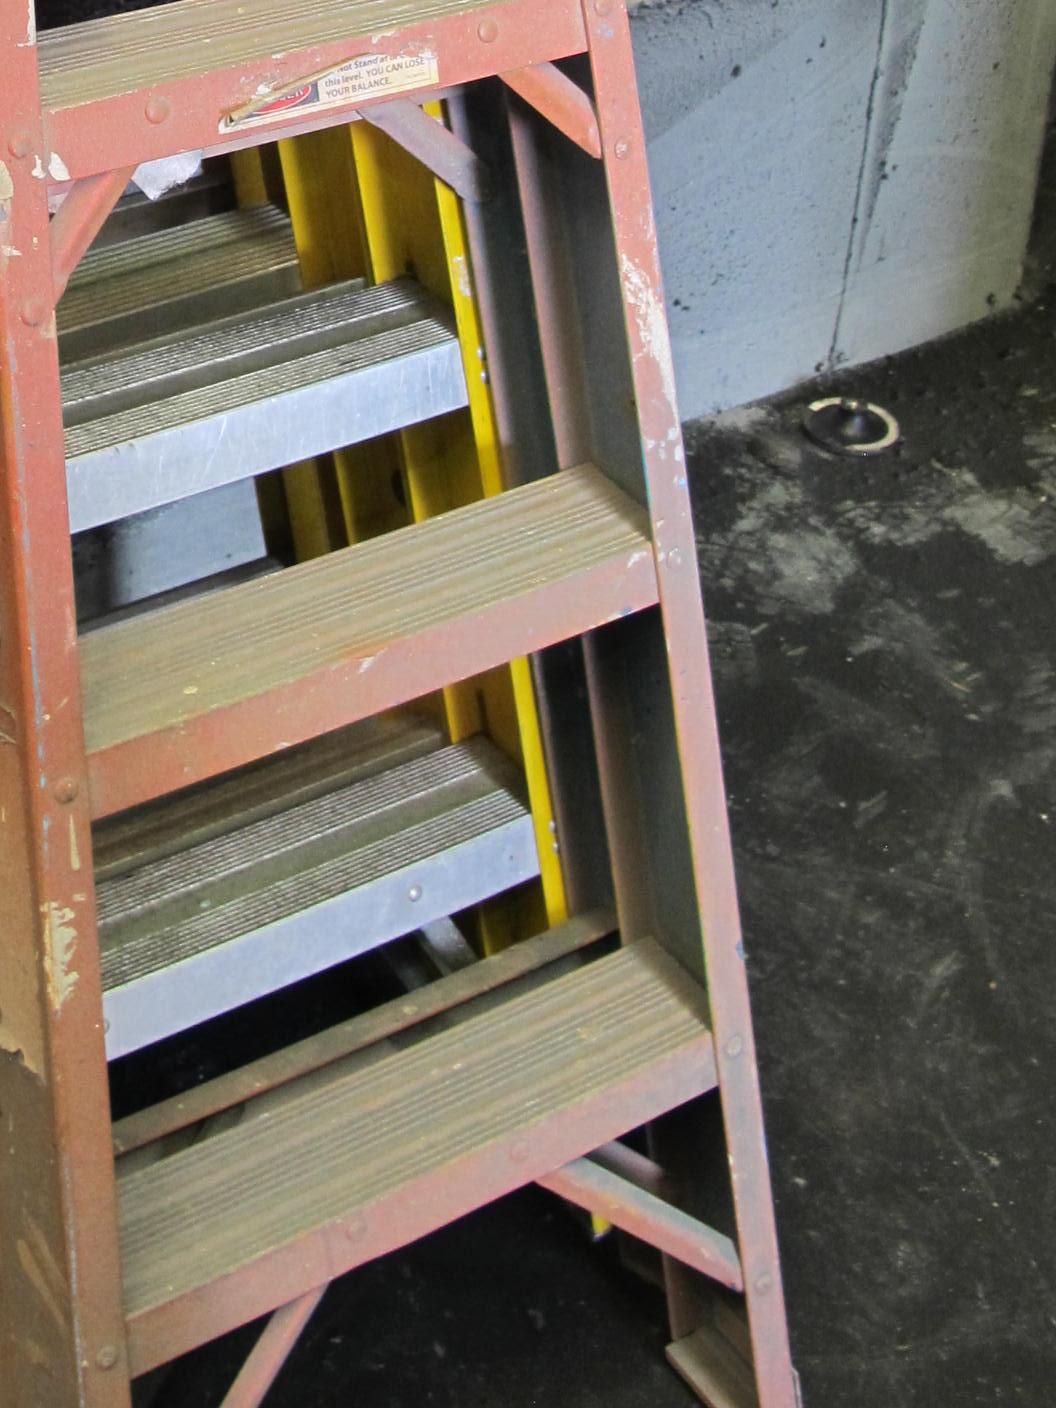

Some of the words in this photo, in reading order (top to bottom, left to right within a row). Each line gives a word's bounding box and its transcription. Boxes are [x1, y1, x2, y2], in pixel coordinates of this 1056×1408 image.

[354, 56, 378, 69] Stand
[325, 78, 341, 88] this
[366, 67, 384, 77] YOU
[386, 63, 403, 73] CAN
[404, 57, 425, 69] LOSE
[326, 86, 350, 99] YOUR
